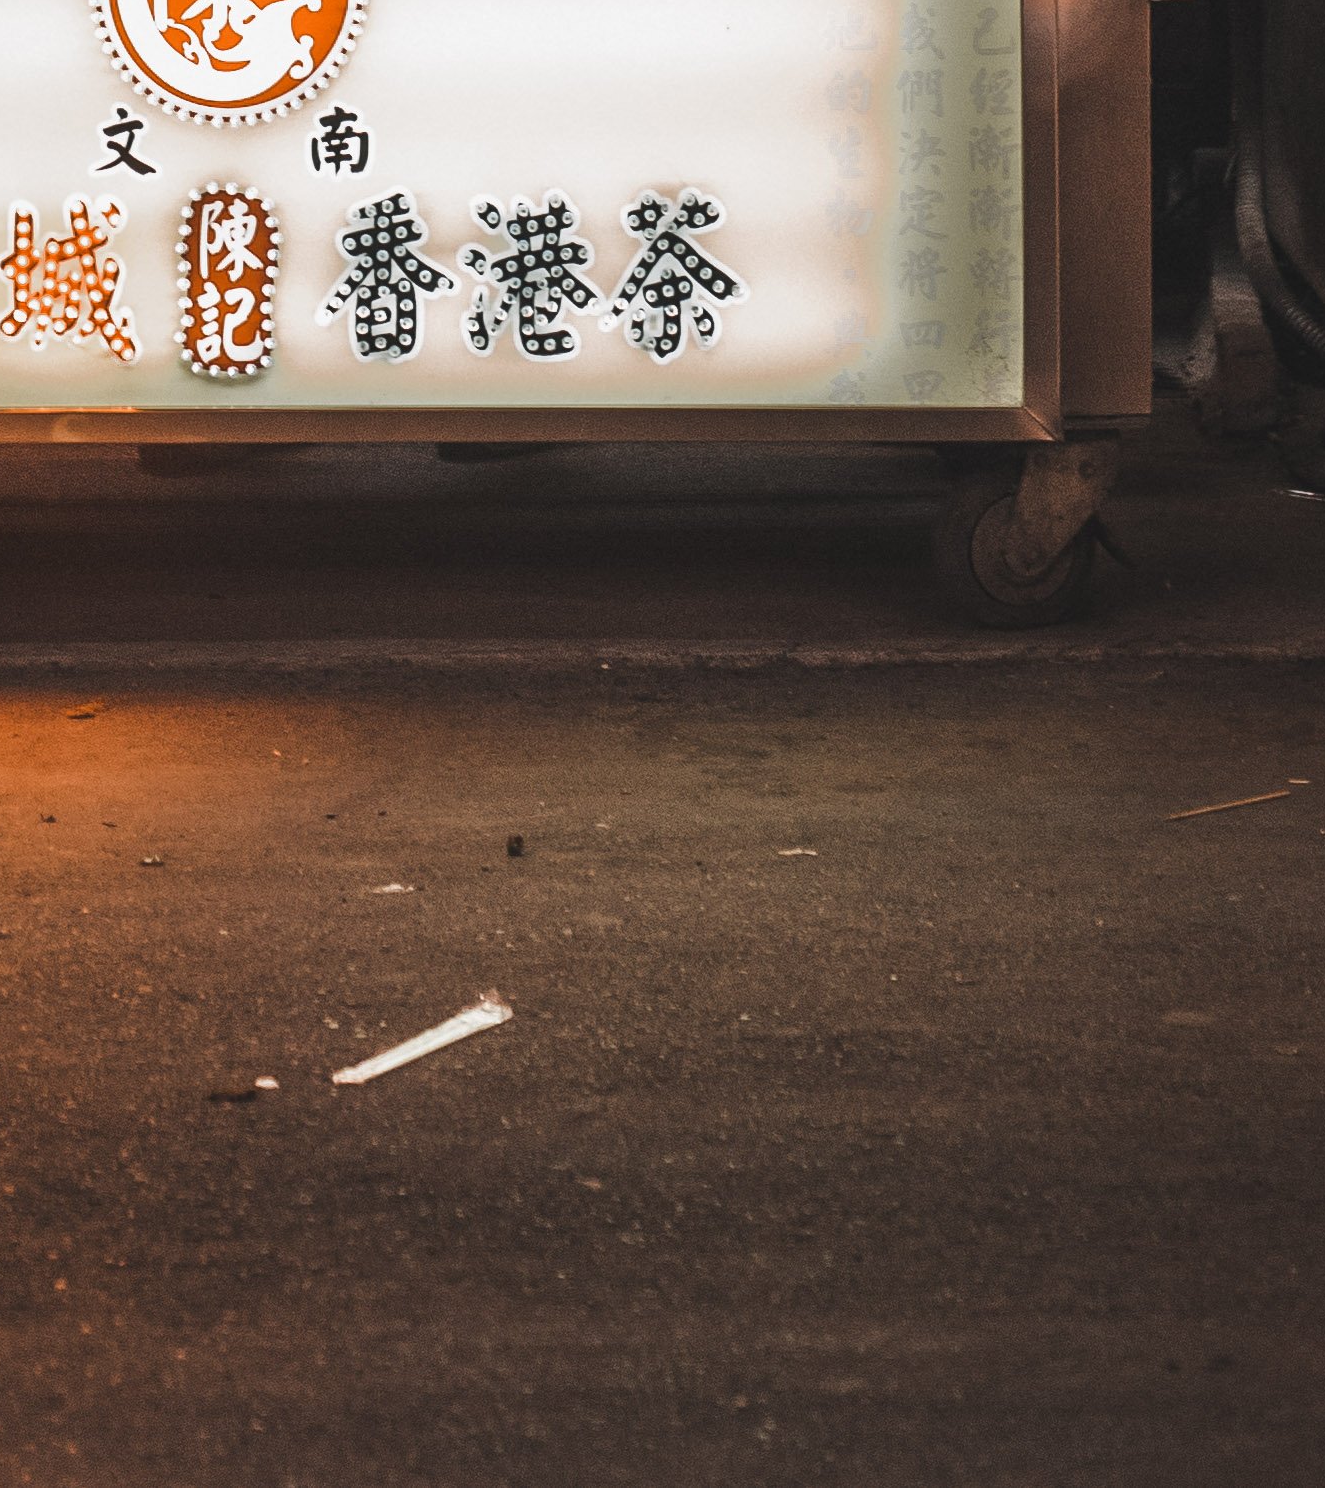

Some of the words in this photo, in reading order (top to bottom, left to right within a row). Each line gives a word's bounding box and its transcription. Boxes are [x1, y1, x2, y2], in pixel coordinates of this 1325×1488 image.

[195, 198, 266, 364] 陳記
[315, 189, 752, 362] 香港茶
